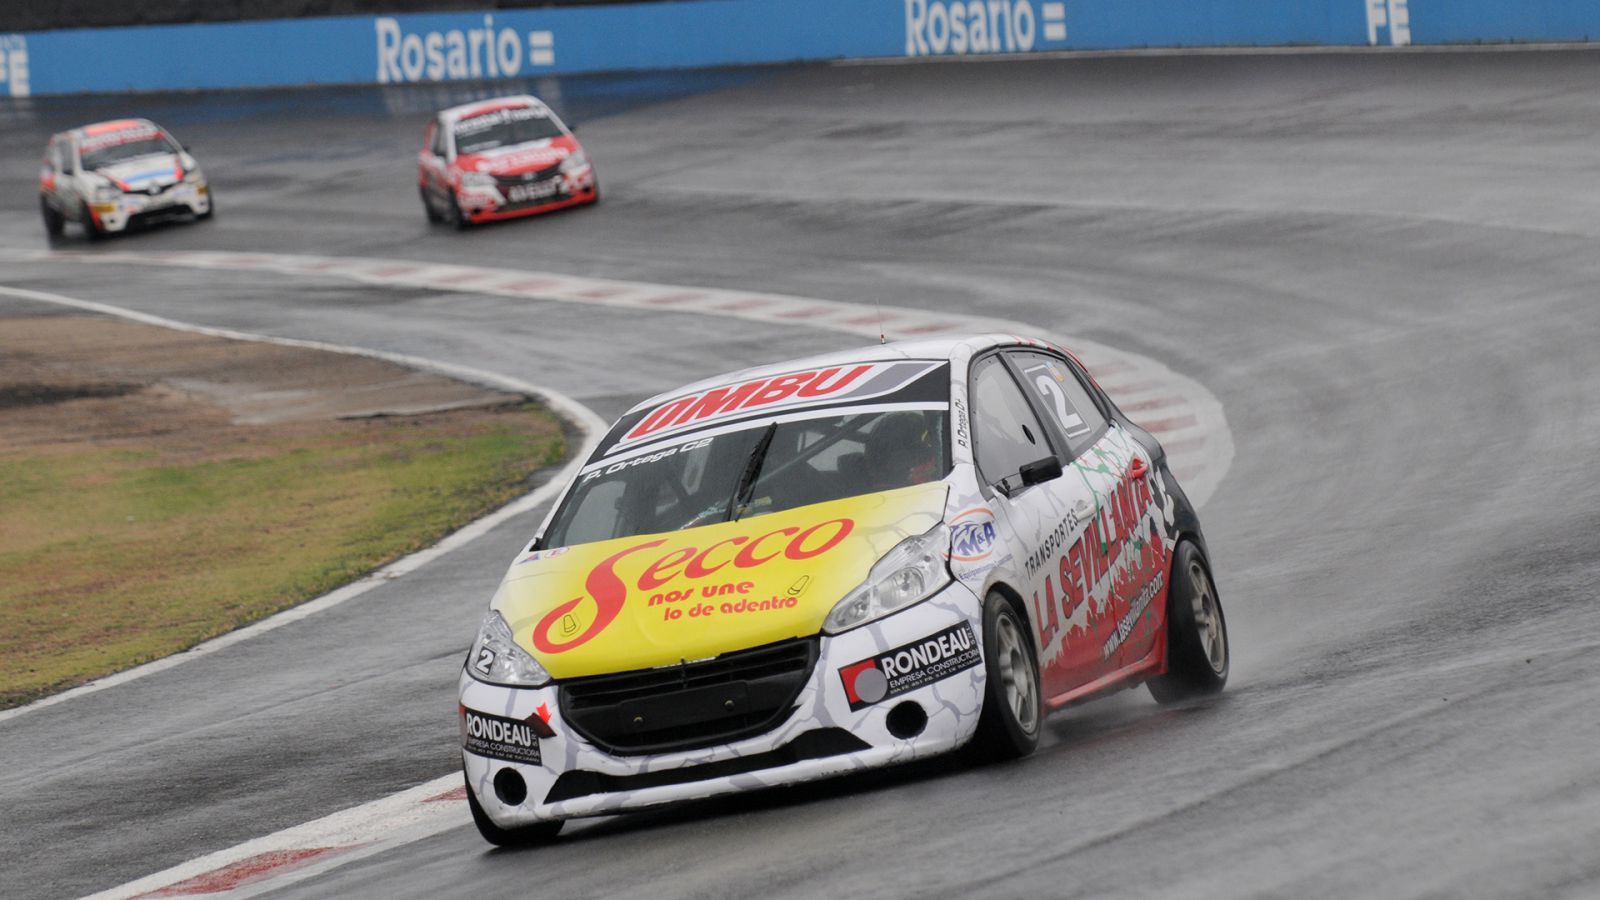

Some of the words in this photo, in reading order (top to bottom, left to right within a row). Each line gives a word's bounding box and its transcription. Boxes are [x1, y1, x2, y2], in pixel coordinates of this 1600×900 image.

[375, 14, 522, 84] Rosario
[905, 0, 1035, 56] Rosario
[627, 364, 875, 440] OMBU
[1036, 375, 1083, 429] 2
[583, 470, 602, 482] P.
[605, 448, 679, 475] Ortega
[1025, 508, 1079, 580] TRANSPORTES
[648, 588, 694, 607] nos
[702, 581, 755, 599] une
[664, 607, 682, 621] lo
[688, 603, 714, 618] de
[720, 596, 798, 617] adentro
[1033, 575, 1059, 650] LA
[476, 648, 494, 675] 2
[881, 627, 971, 679] RONDEAU
[889, 670, 926, 689] EMPRESA
[926, 648, 980, 675] CONSTRUCTORA
[466, 713, 532, 747] RONDEAU
[489, 742, 540, 758] CONSTRUCTORA
